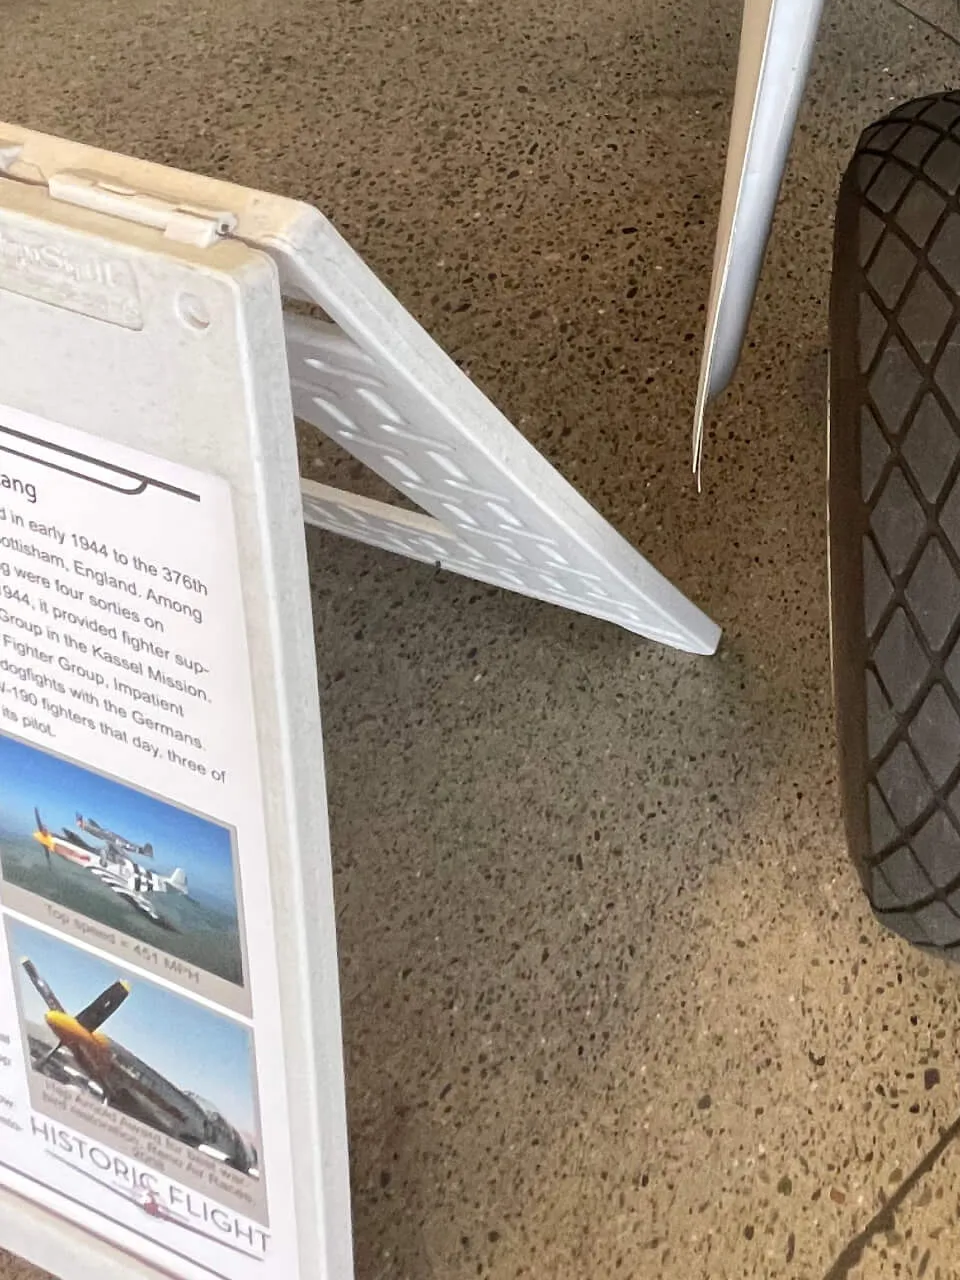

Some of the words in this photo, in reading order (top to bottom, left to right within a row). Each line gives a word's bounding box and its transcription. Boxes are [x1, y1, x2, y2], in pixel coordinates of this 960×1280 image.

[0, 474, 37, 503] ang
[10, 510, 25, 528] in
[28, 520, 65, 545] early
[71, 533, 109, 558] 1944
[112, 548, 129, 566] to
[132, 556, 158, 577] the
[162, 567, 208, 596] 376th
[14, 566, 50, 589] were
[55, 579, 85, 601] four
[88, 595, 140, 623] sorties
[143, 616, 164, 633] on
[39, 597, 49, 614] it
[52, 606, 118, 640] provided
[121, 630, 171, 660] fighter
[174, 654, 210, 675] sup-
[146, 588, 203, 624] Among
[0, 607, 43, 637] Group
[46, 625, 60, 643] in
[63, 633, 88, 654] the
[91, 644, 144, 676] Kassel
[148, 665, 213, 704] Mission.
[0, 658, 66, 694] dogfights
[69, 687, 100, 708] with
[103, 699, 128, 719] the
[3, 633, 55, 664] Fighter
[113, 676, 185, 718] Impatient
[2, 704, 19, 722] its
[41, 697, 97, 731] fighters
[100, 721, 129, 745] that
[167, 749, 207, 775] three
[211, 768, 227, 785] of
[31, 1114, 159, 1192] HISTORIC
[169, 1184, 271, 1252] FLIGHT
